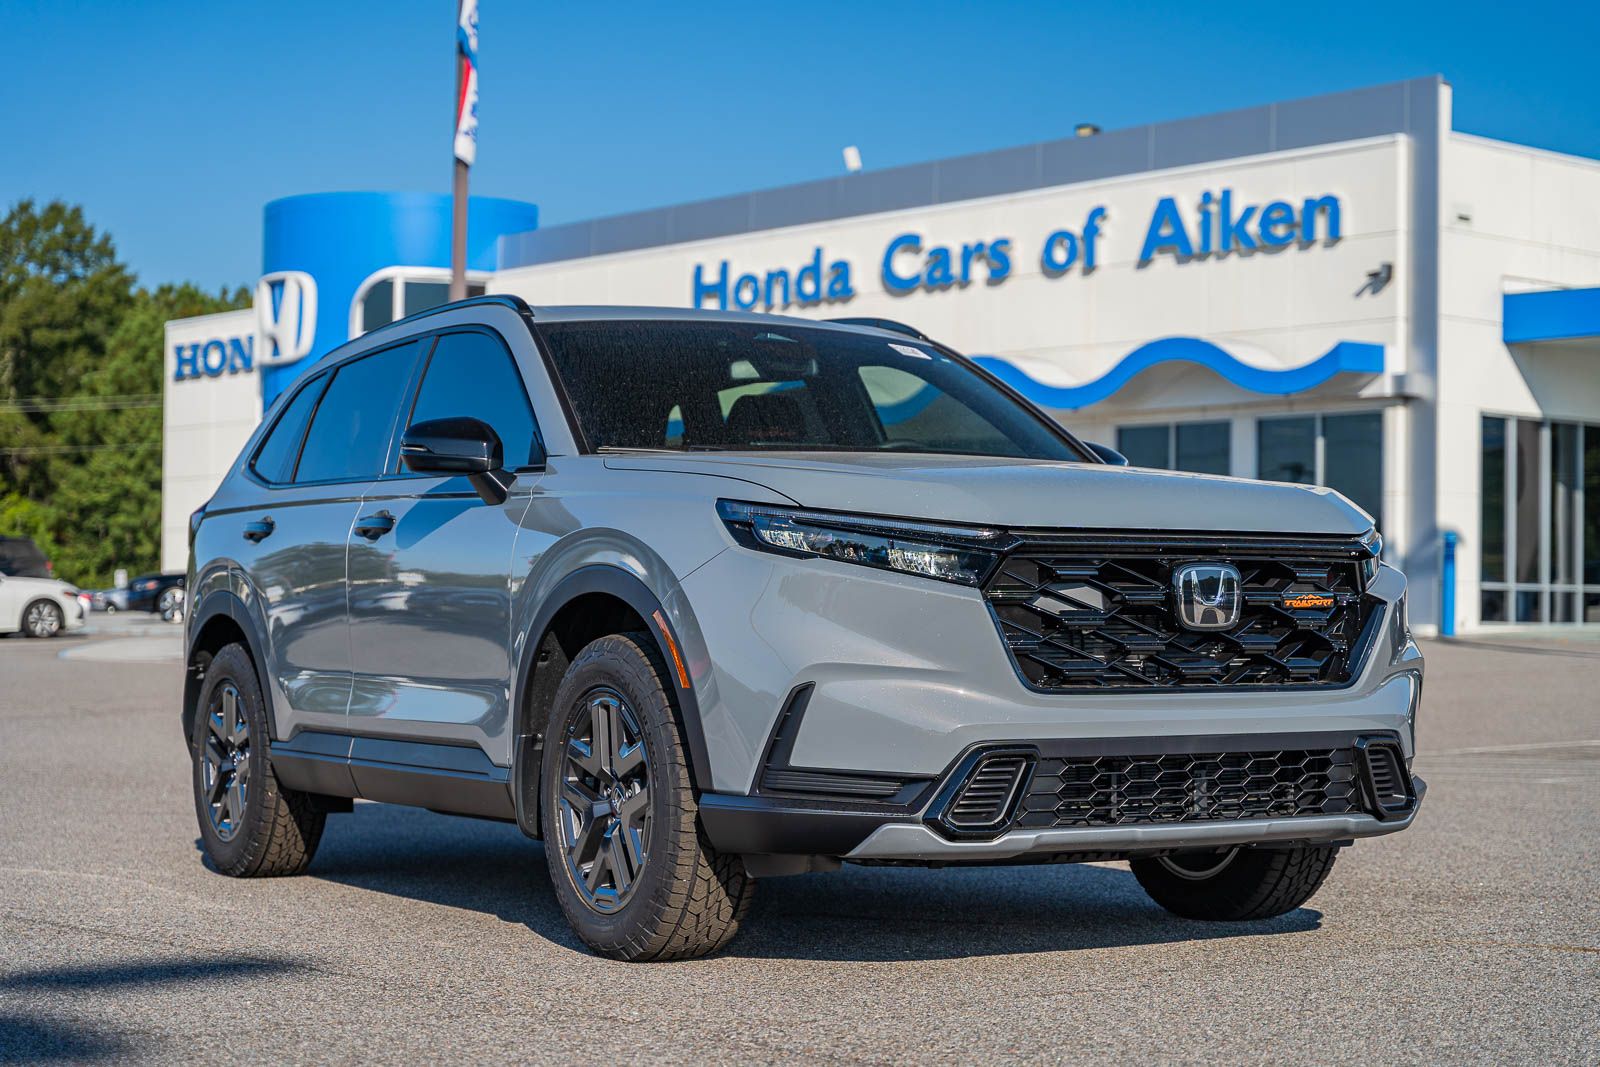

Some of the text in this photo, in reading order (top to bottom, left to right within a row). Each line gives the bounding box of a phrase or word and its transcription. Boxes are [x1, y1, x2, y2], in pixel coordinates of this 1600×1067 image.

[693, 188, 1341, 310] Honda Cars of Aiken
